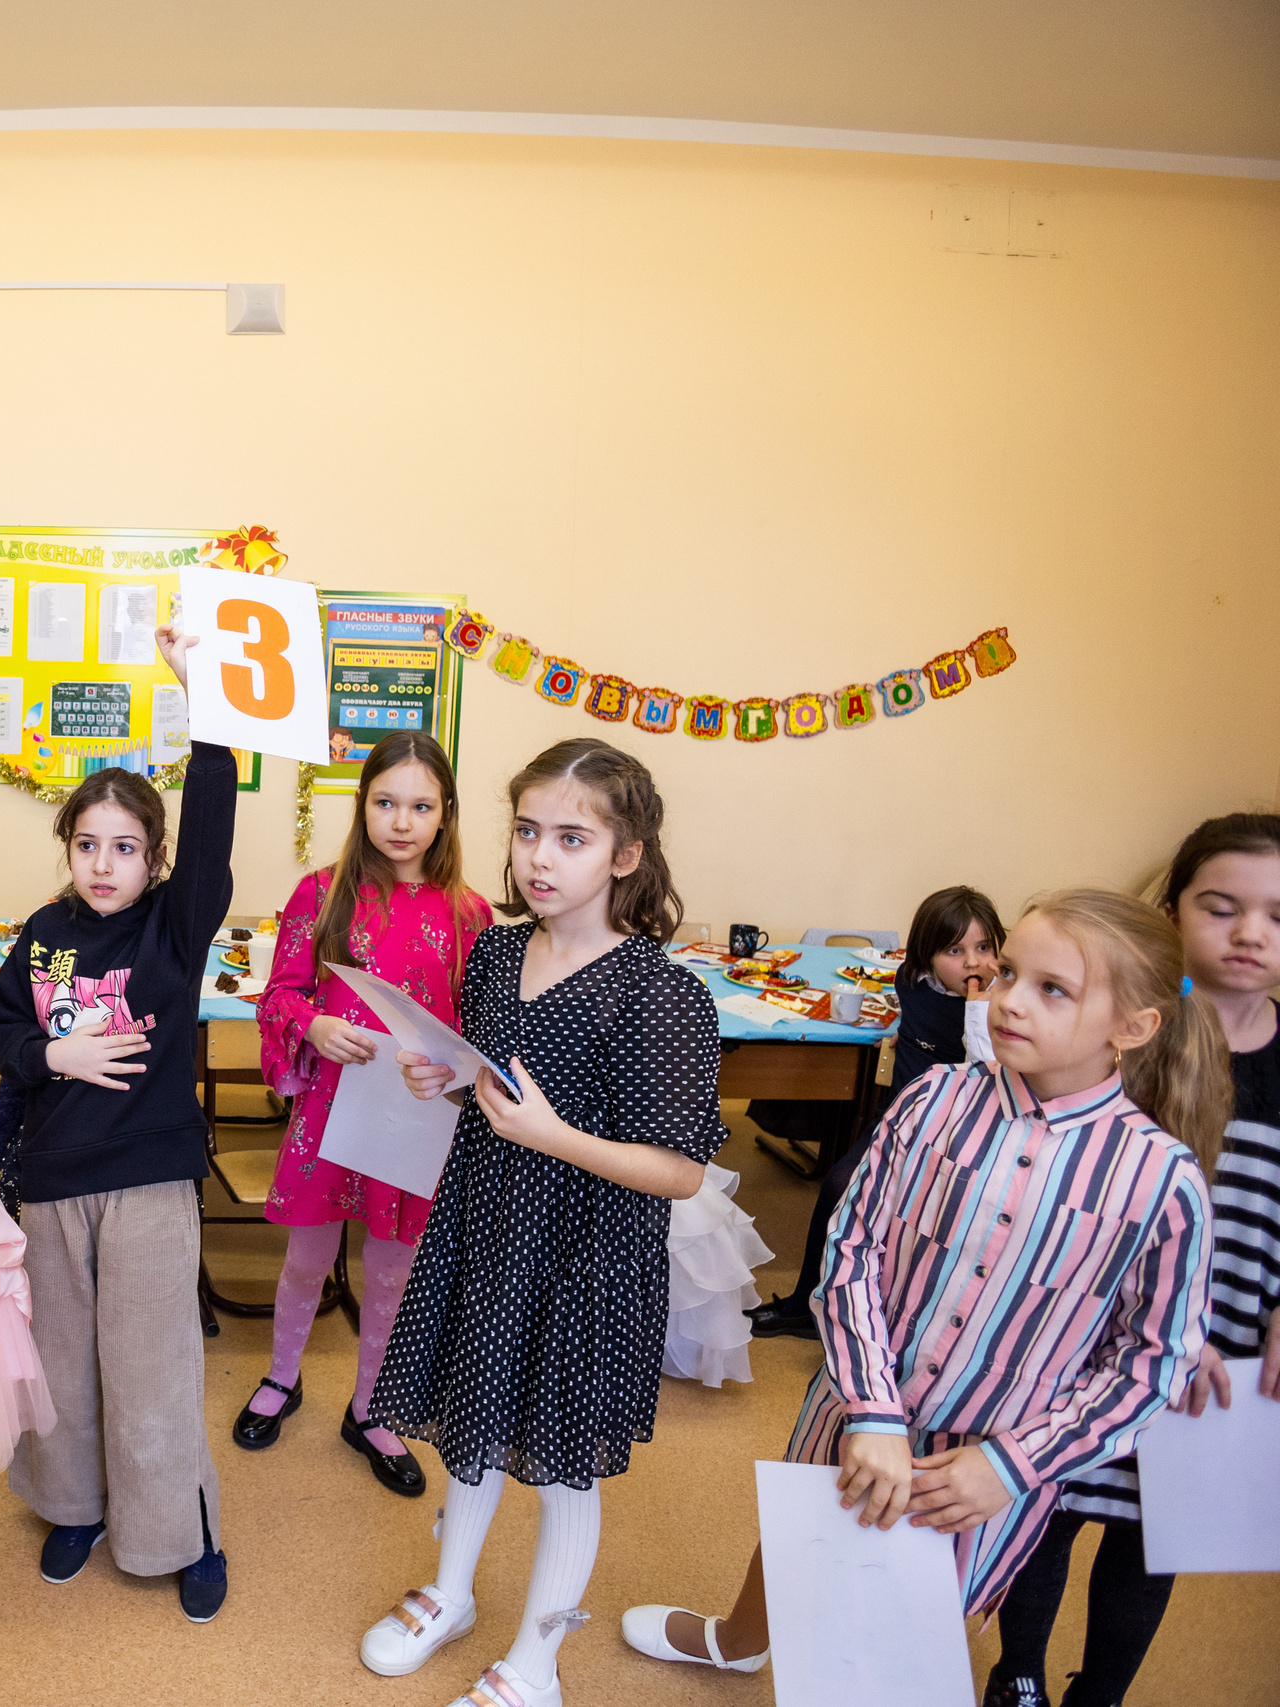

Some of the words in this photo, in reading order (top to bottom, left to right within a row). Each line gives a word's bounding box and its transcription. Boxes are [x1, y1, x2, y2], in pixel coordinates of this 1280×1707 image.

[112, 546, 200, 570] УГОЛОК
[336, 611, 393, 623] ГЛАСНЫЕ
[397, 613, 435, 624] ЗВУКИ
[345, 623, 390, 632] РУССКОГО
[392, 625, 421, 633] ЯЗЫКА
[341, 698, 387, 706] ОБОЗНАЧАЮТ
[388, 699, 401, 707] ДВА
